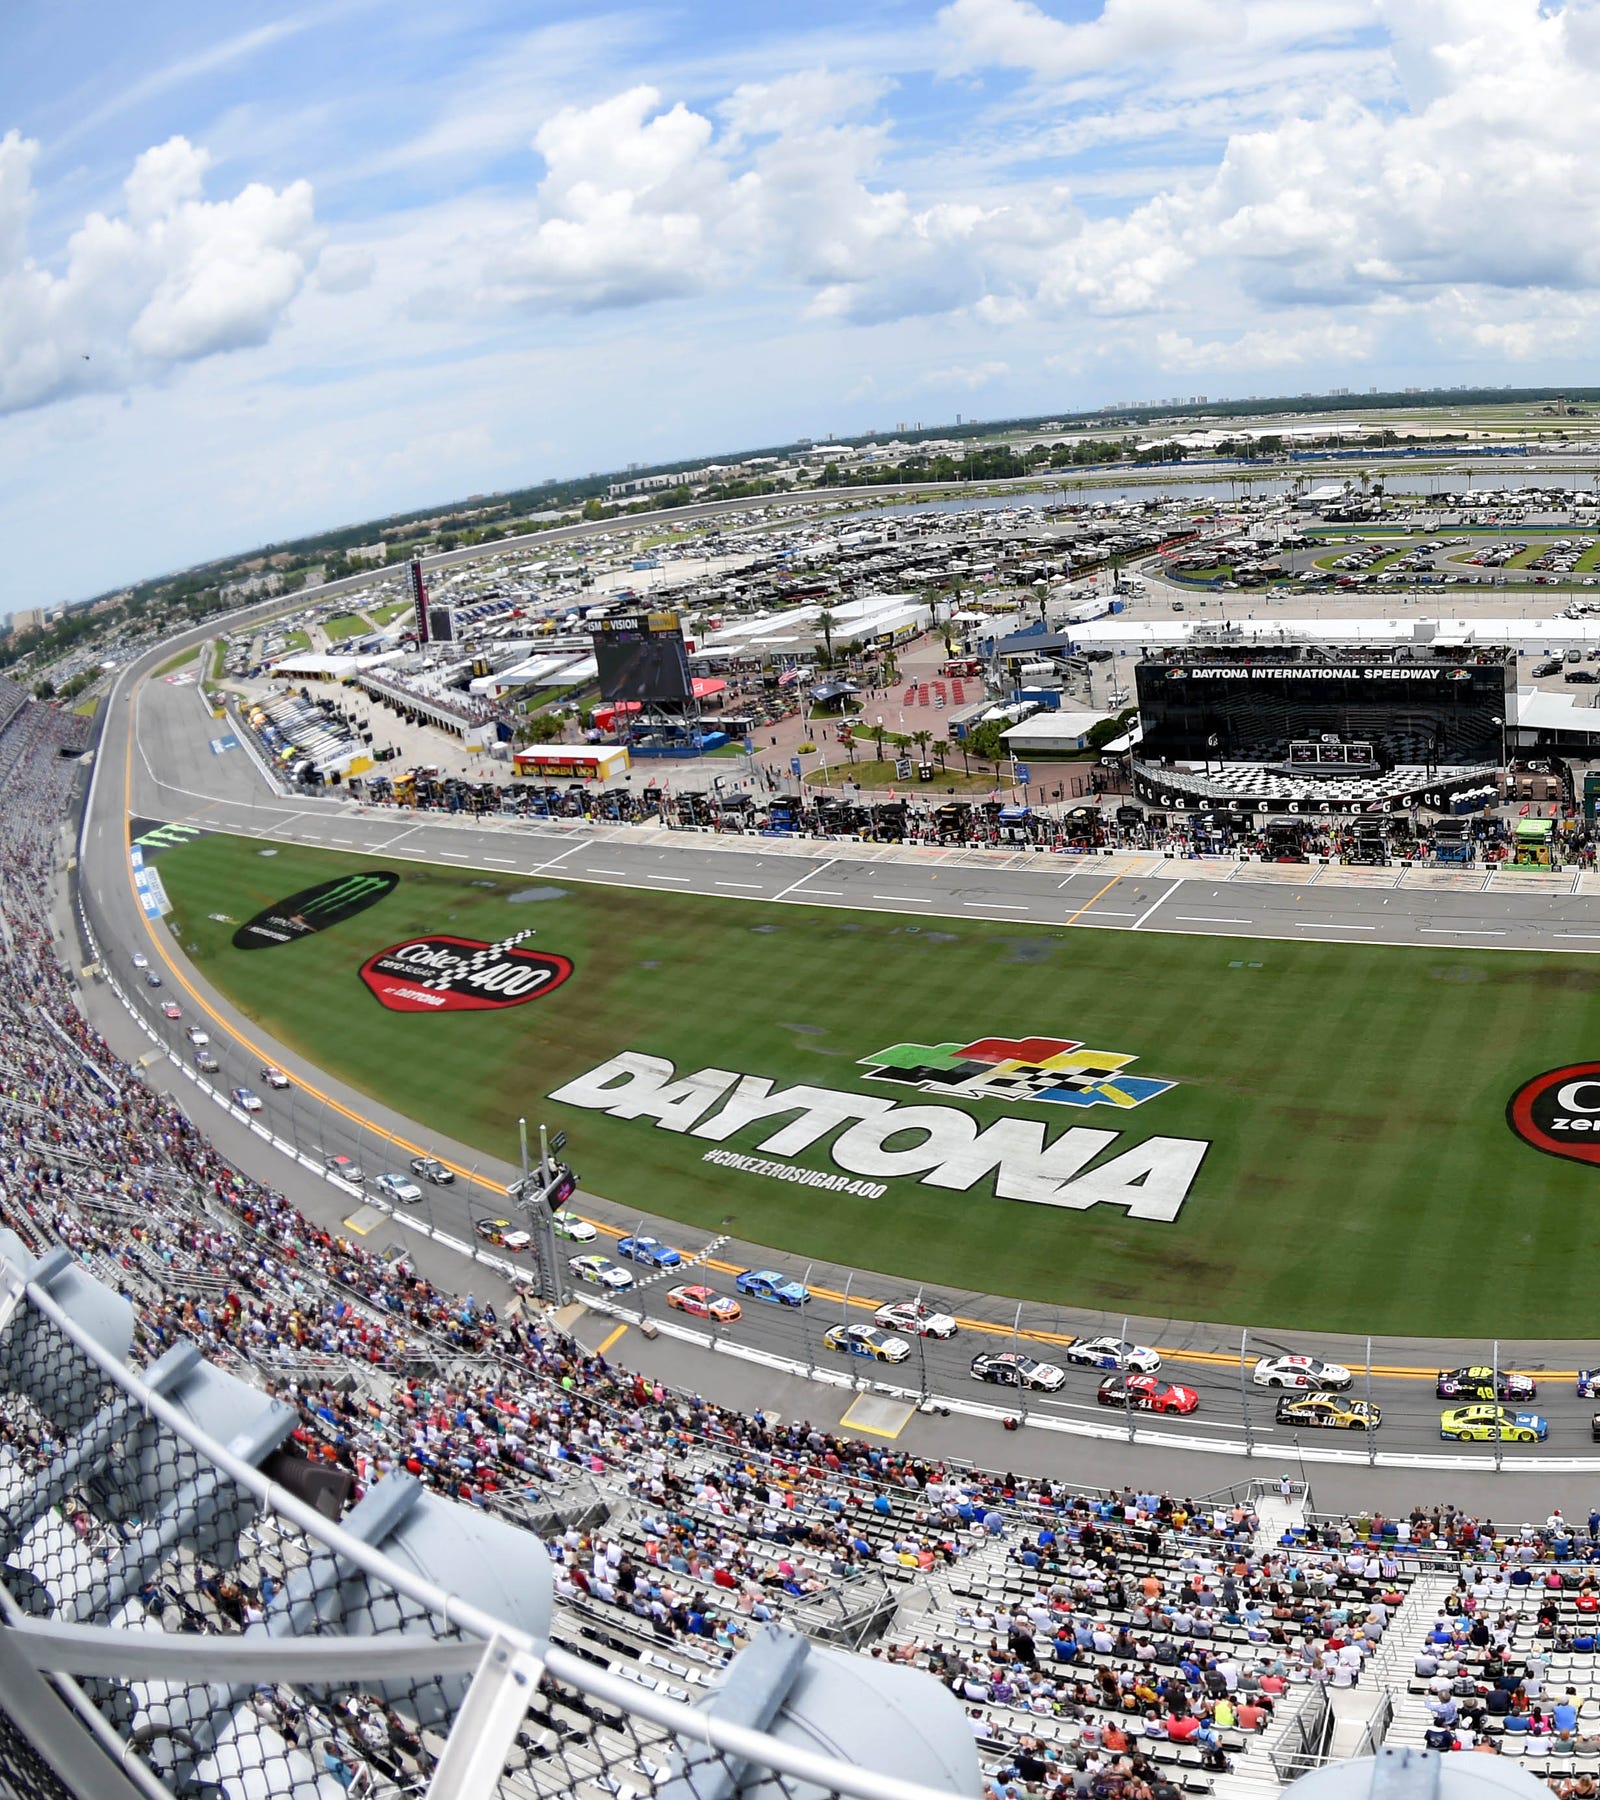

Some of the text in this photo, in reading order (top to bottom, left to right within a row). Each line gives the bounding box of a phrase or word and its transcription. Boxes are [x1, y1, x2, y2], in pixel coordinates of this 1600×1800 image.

[588, 622, 601, 631] ISM
[611, 619, 638, 631] VISION
[1192, 669, 1440, 680] DAYTONA INTERNATIONAL SPEEDWAY
[1160, 794, 1170, 806] G
[1175, 798, 1185, 809] G
[1199, 800, 1209, 811] G
[1258, 801, 1268, 812] G
[1288, 802, 1298, 813] G
[1351, 803, 1361, 814] G
[1382, 801, 1391, 812] G
[1402, 796, 1412, 807] G
[396, 943, 462, 969] Coke
[378, 959, 436, 977] zero SUGAR
[468, 962, 552, 996] 400
[395, 987, 447, 1006] DAYTONA
[547, 1050, 1211, 1223] DAYTONA
[702, 1149, 887, 1199] #COKEZEROSUGAR400
[1295, 1376, 1307, 1386] 8
[1477, 1386, 1495, 1399] 48
[1138, 1398, 1153, 1409] 41
[1322, 1416, 1337, 1426] 10
